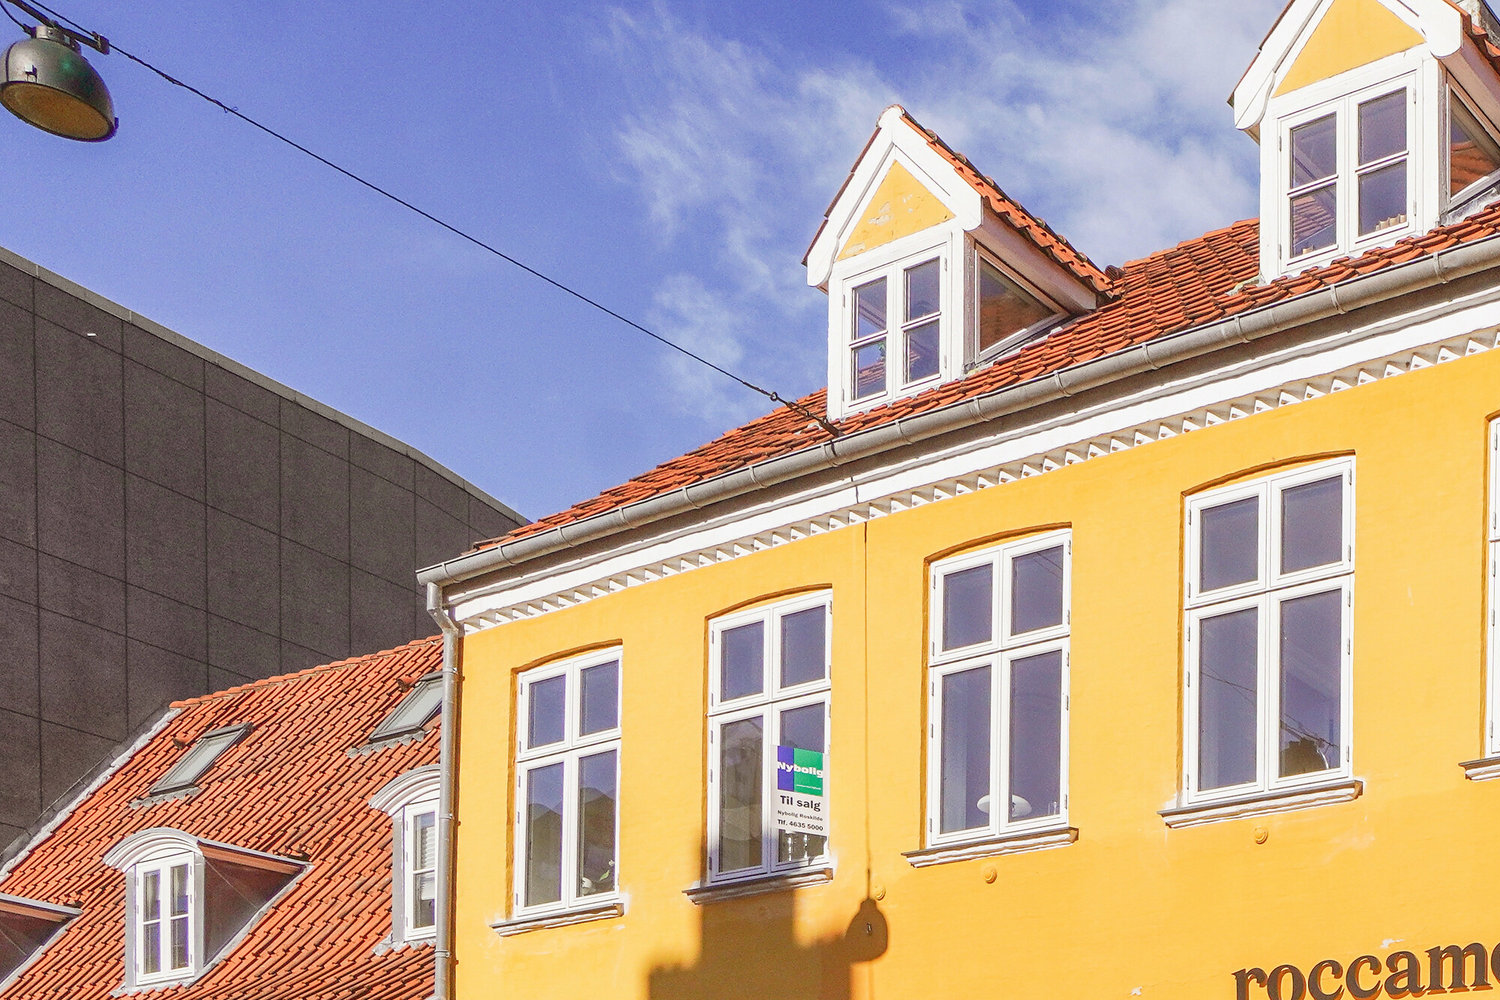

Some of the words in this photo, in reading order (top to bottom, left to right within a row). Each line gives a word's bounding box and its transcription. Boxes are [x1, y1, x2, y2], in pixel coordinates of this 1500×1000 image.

[777, 761, 824, 778] Nybolig
[780, 795, 793, 806] Til
[797, 799, 821, 812] salg
[777, 809, 799, 818] Nybolig
[800, 813, 823, 821] Roskilde
[789, 820, 806, 828] 4635
[807, 823, 824, 831] 5000
